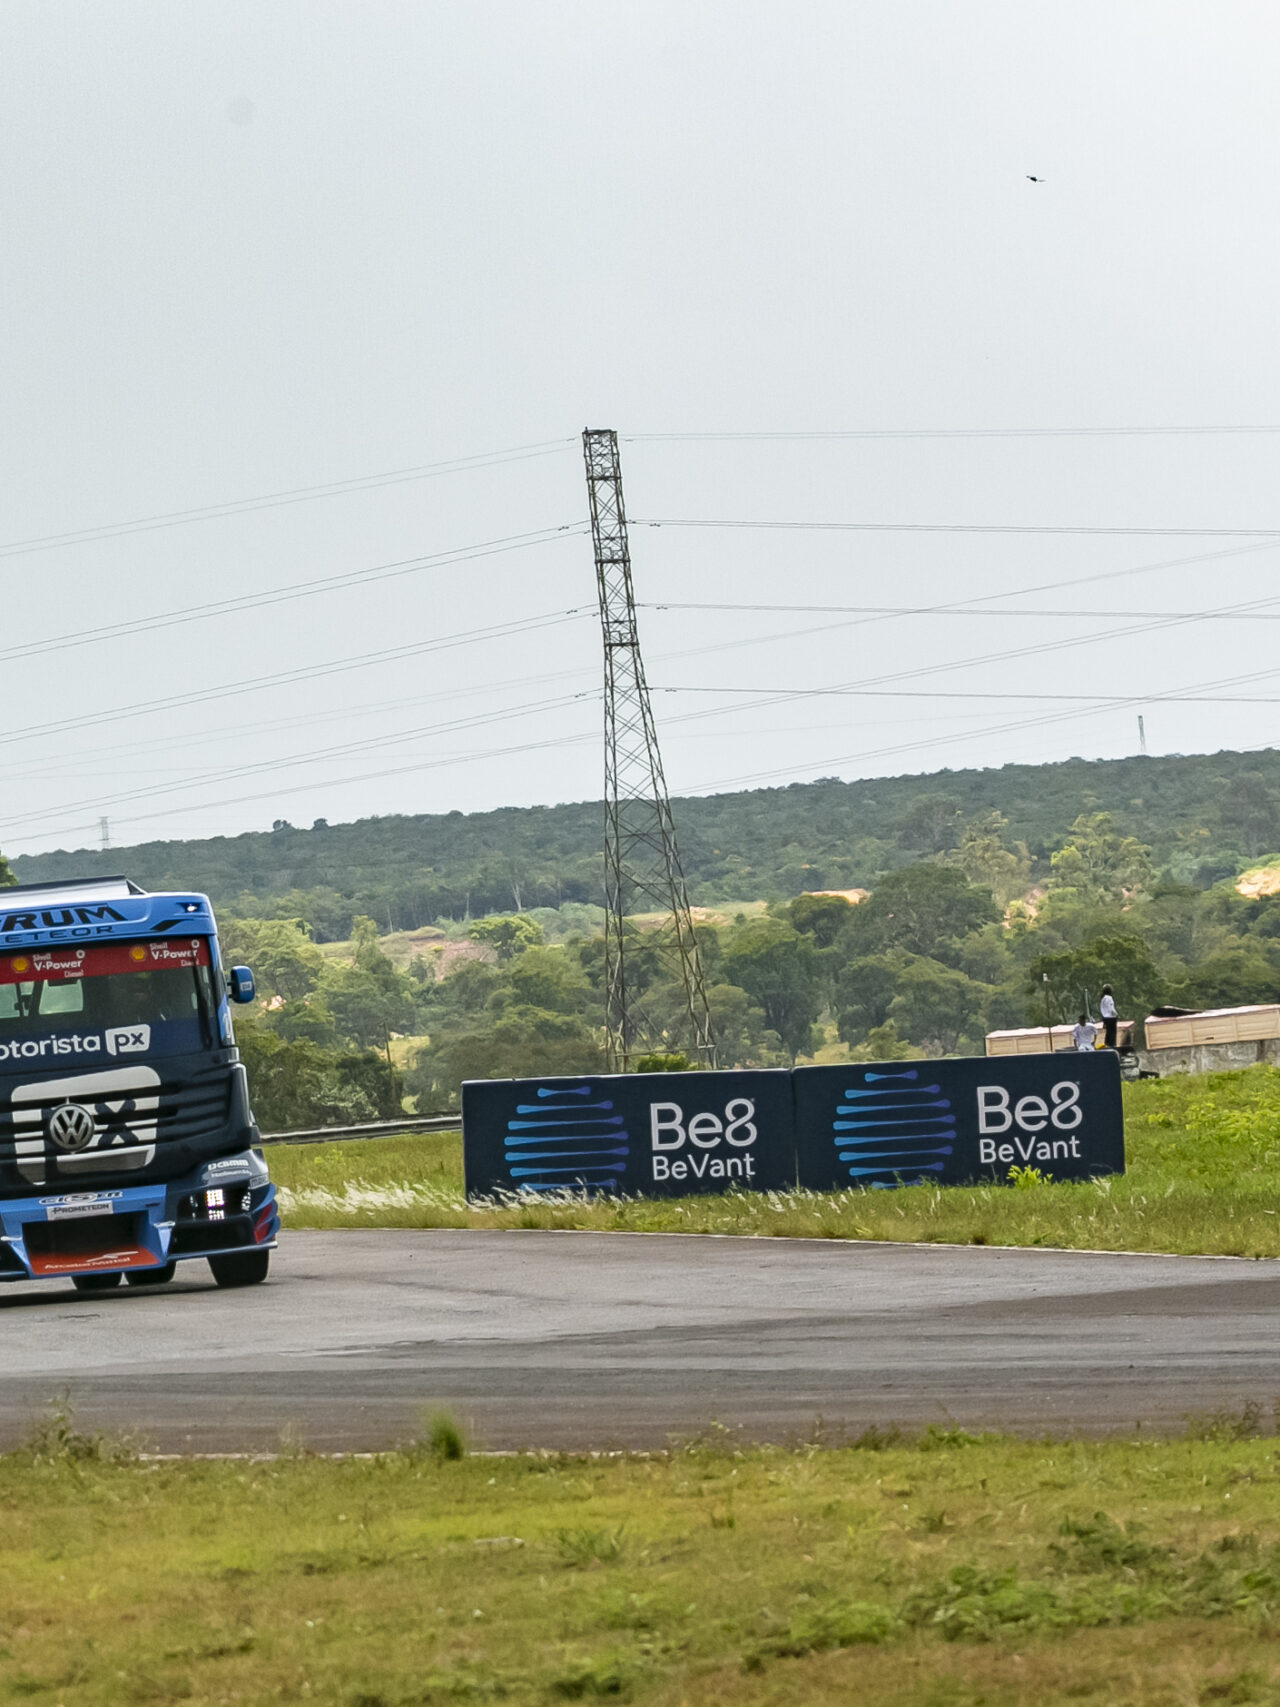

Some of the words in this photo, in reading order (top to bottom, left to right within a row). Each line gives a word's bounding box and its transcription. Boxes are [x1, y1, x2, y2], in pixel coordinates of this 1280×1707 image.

[34, 960, 82, 971] V-Power
[150, 949, 198, 961] V-Power
[977, 1081, 1084, 1134] Be8
[650, 1098, 758, 1151] Be8
[979, 1135, 1082, 1163] BeVant
[652, 1152, 756, 1181] BeVant
